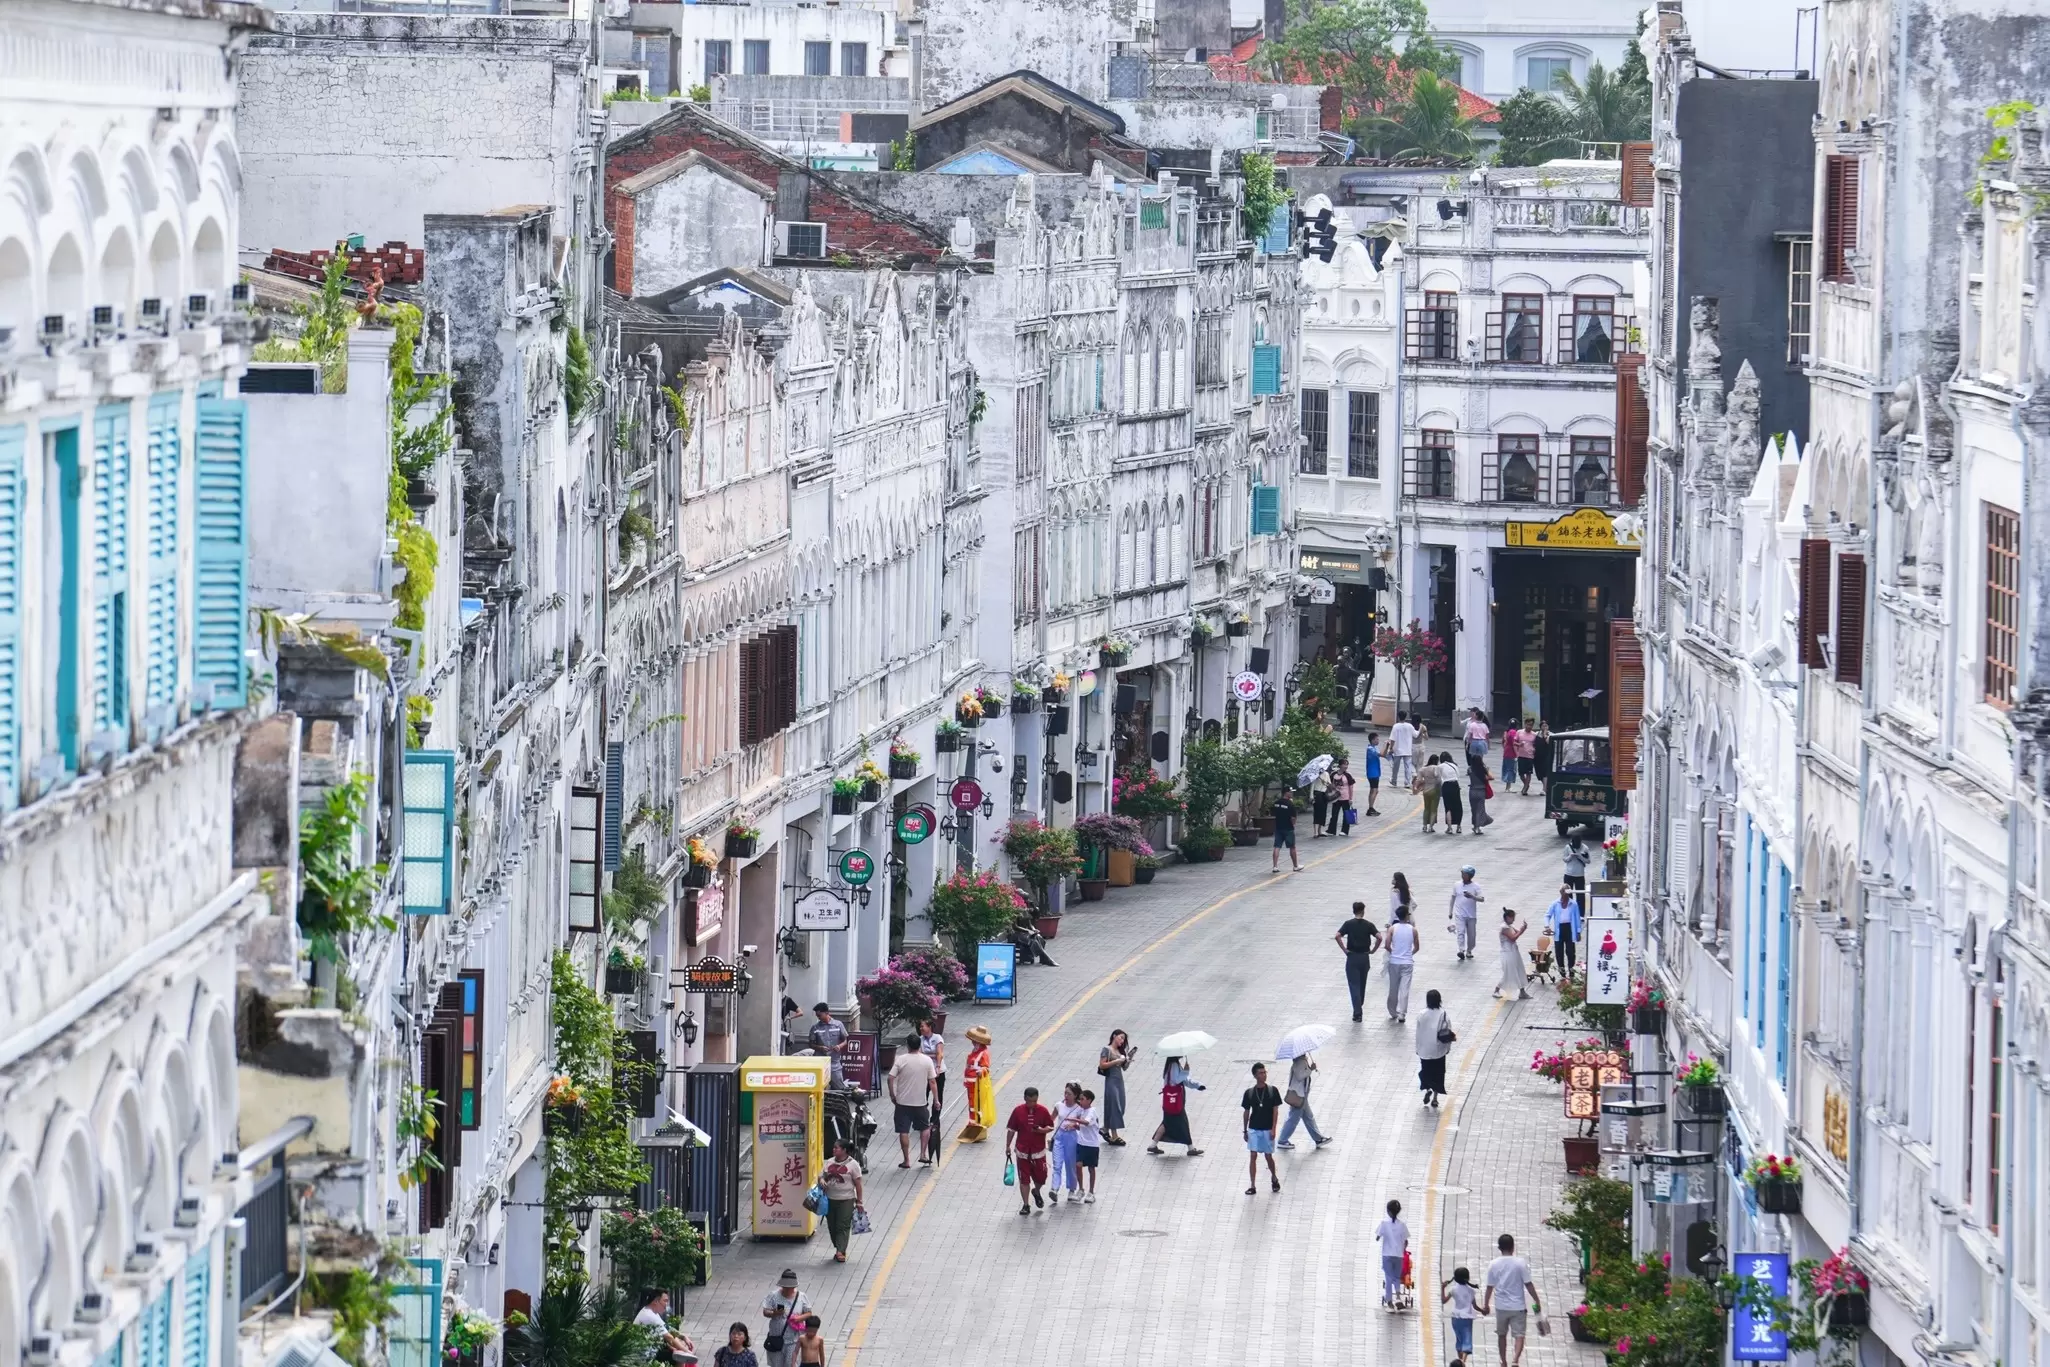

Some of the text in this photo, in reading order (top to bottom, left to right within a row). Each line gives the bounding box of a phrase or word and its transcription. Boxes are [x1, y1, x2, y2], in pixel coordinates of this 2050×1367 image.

[818, 908, 842, 916] 卫生间
[1609, 1120, 1629, 1145] 香
[1653, 1170, 1672, 1197] 香
